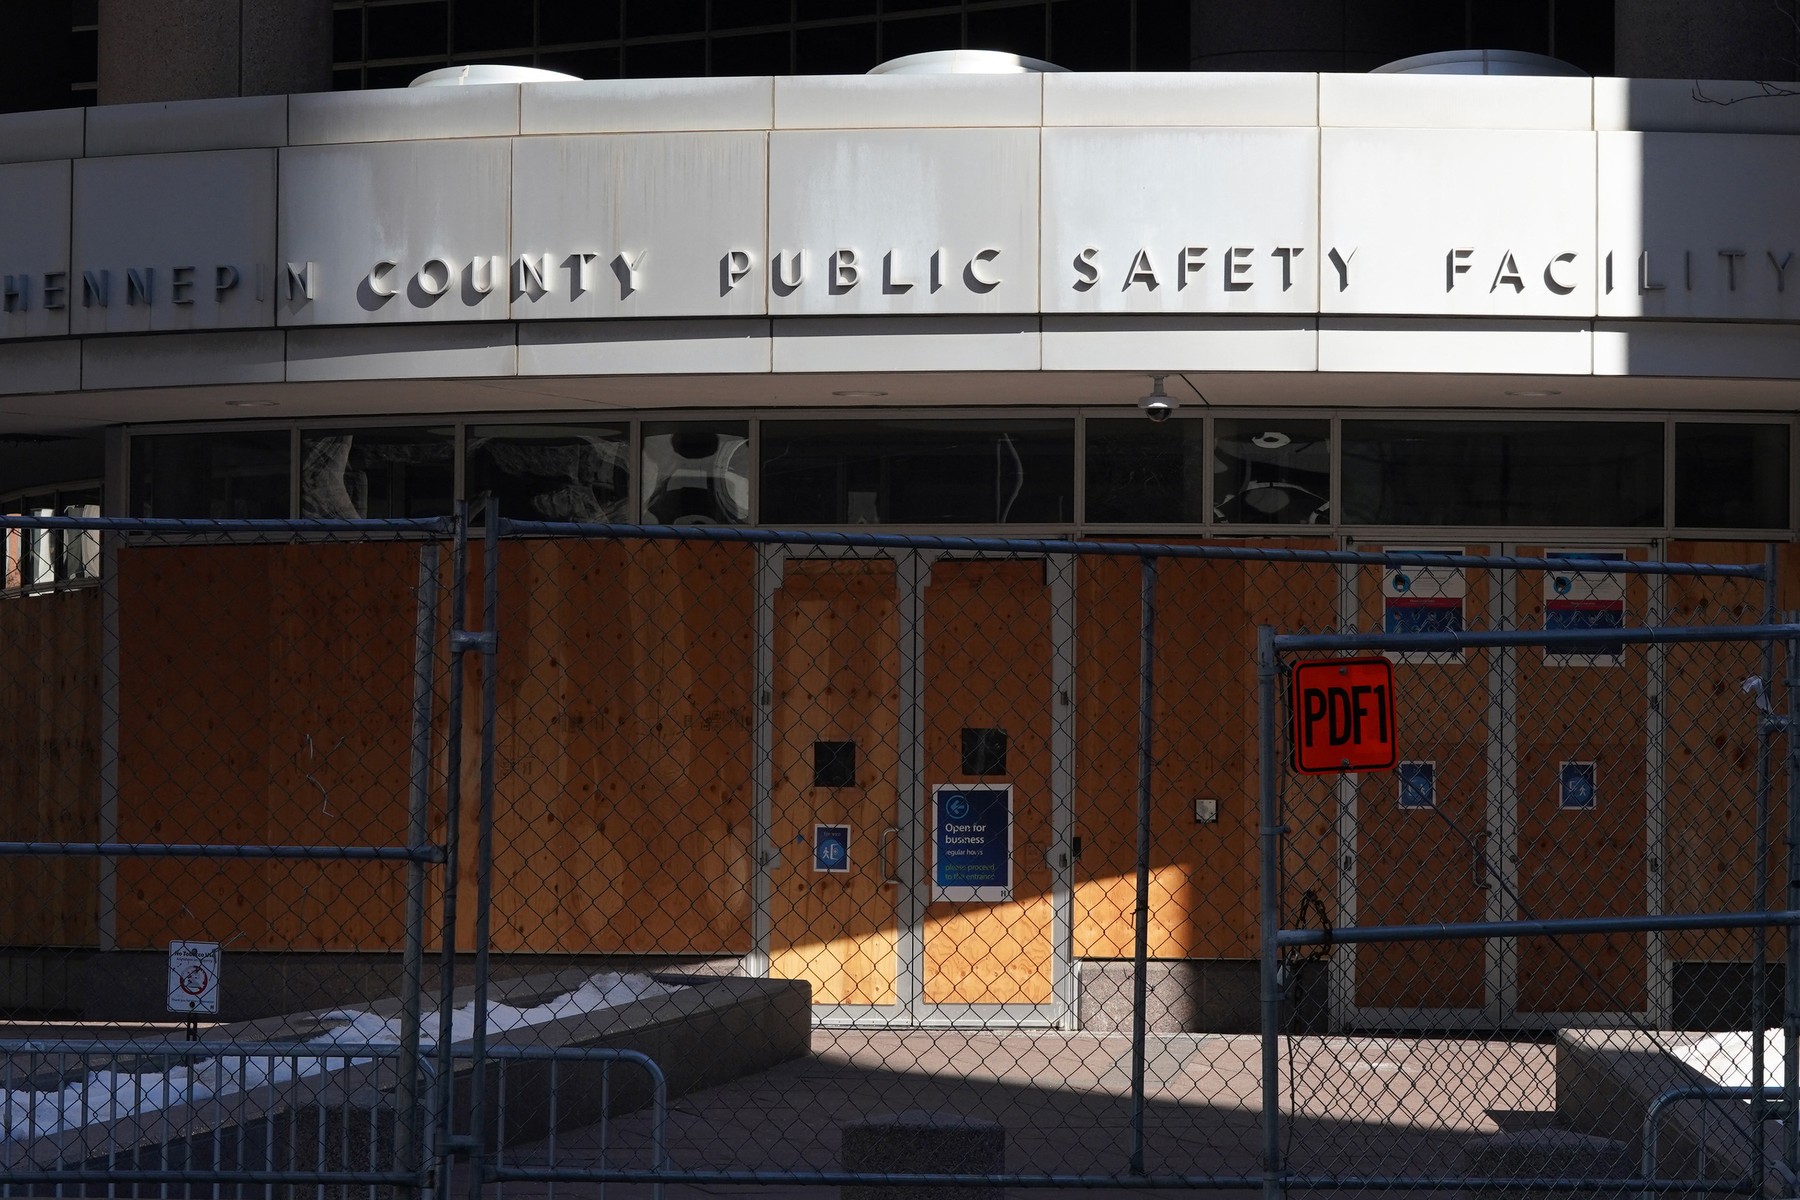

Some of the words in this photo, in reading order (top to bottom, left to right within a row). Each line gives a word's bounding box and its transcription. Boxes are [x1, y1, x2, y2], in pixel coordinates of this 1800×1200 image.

[3, 262, 314, 312] HENNEPIN
[362, 250, 648, 303] COUNTY
[723, 247, 1003, 293] PUBLIC
[1073, 246, 1358, 291] SAFETY
[1448, 246, 1794, 293] FACILITY
[1304, 685, 1388, 747] PDF1
[945, 823, 970, 834] Open
[973, 823, 986, 832] for
[945, 835, 985, 844] business
